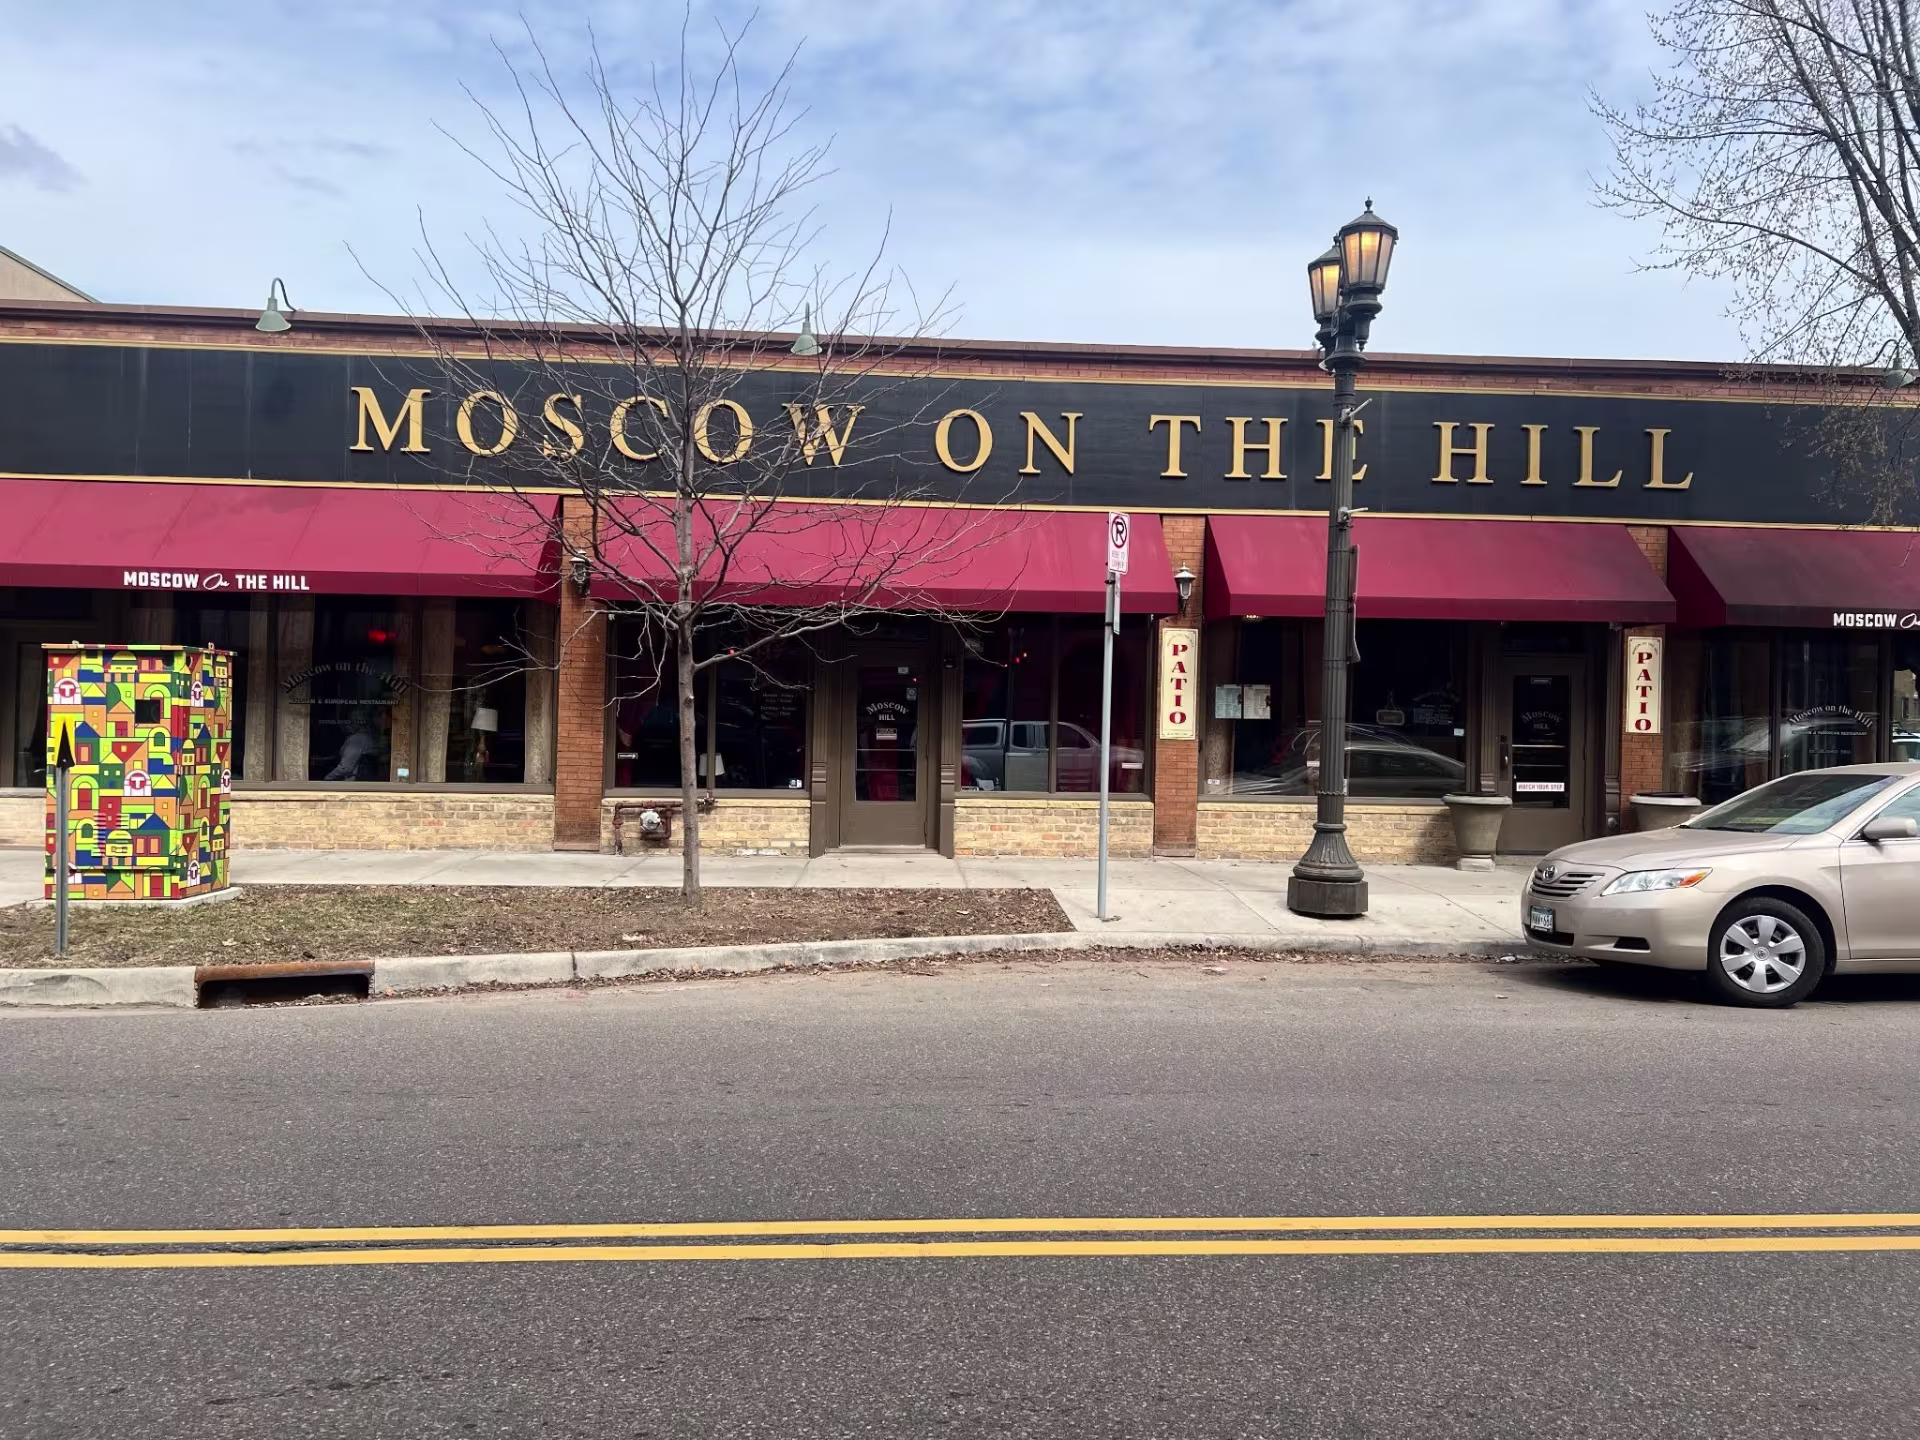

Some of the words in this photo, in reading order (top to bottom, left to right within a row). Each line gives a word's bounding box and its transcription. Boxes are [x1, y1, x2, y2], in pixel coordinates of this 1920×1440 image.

[349, 387, 867, 466] MOSCOW
[935, 408, 1084, 475] ON
[1148, 413, 1368, 483] THE
[1431, 420, 1695, 490] HILL
[123, 571, 200, 589] MOSCOW
[235, 574, 268, 590] THE
[273, 574, 310, 591] HILL
[1833, 612, 1897, 628] MOSCOW
[1169, 643, 1188, 725] PATIO
[1634, 651, 1653, 731] PATIO
[878, 713, 896, 721] HILL
[1788, 704, 1824, 725] Moscow
